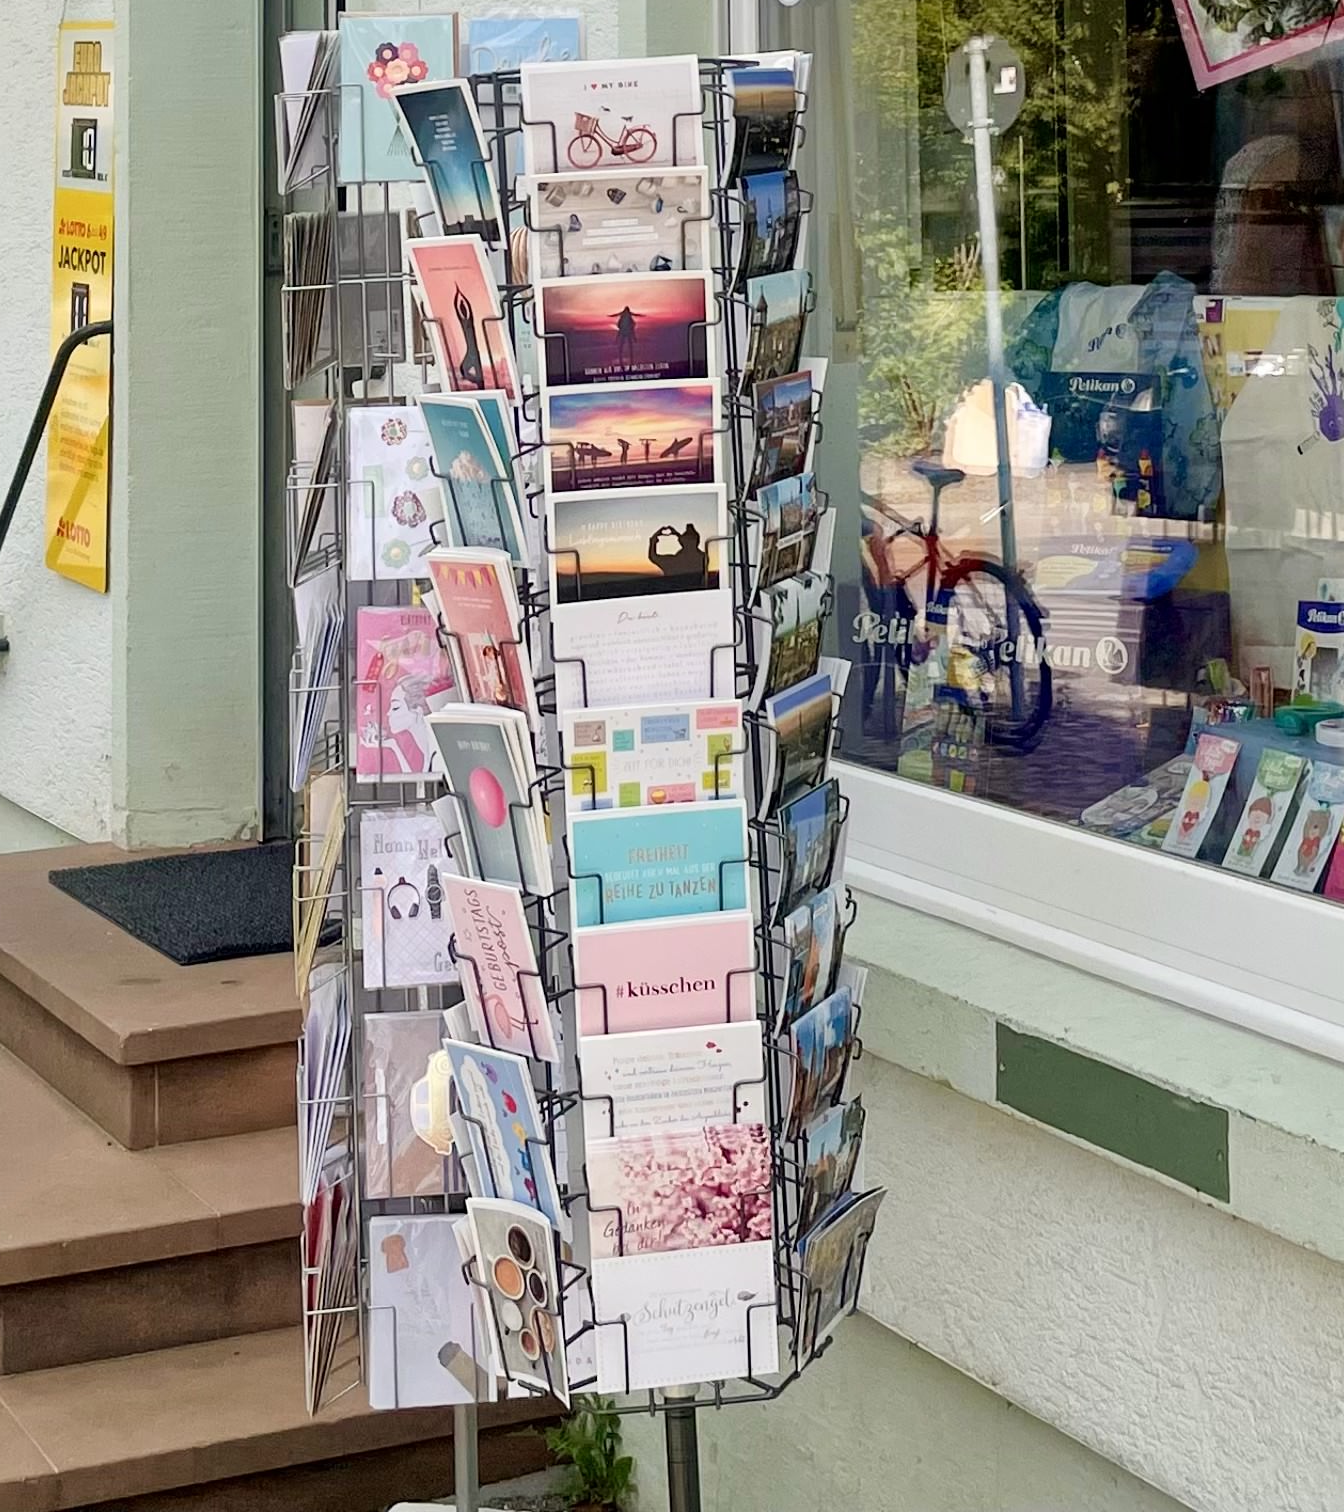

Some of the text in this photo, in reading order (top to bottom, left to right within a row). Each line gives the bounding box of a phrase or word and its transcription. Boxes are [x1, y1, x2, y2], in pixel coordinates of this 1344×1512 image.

[58, 245, 106, 275] JACKPOT
[1069, 377, 1119, 393] Pelikan
[992, 627, 1092, 669] Pelikan
[628, 844, 689, 864] FREIHEIT
[605, 876, 716, 904] REIHE ZU TANZEN
[464, 888, 507, 991] GEBURTSTAGS
[616, 976, 716, 999] #küsschen
[626, 1201, 640, 1216] In
[603, 1217, 664, 1239] Gedanken
[633, 1289, 735, 1327] Schutzengel
